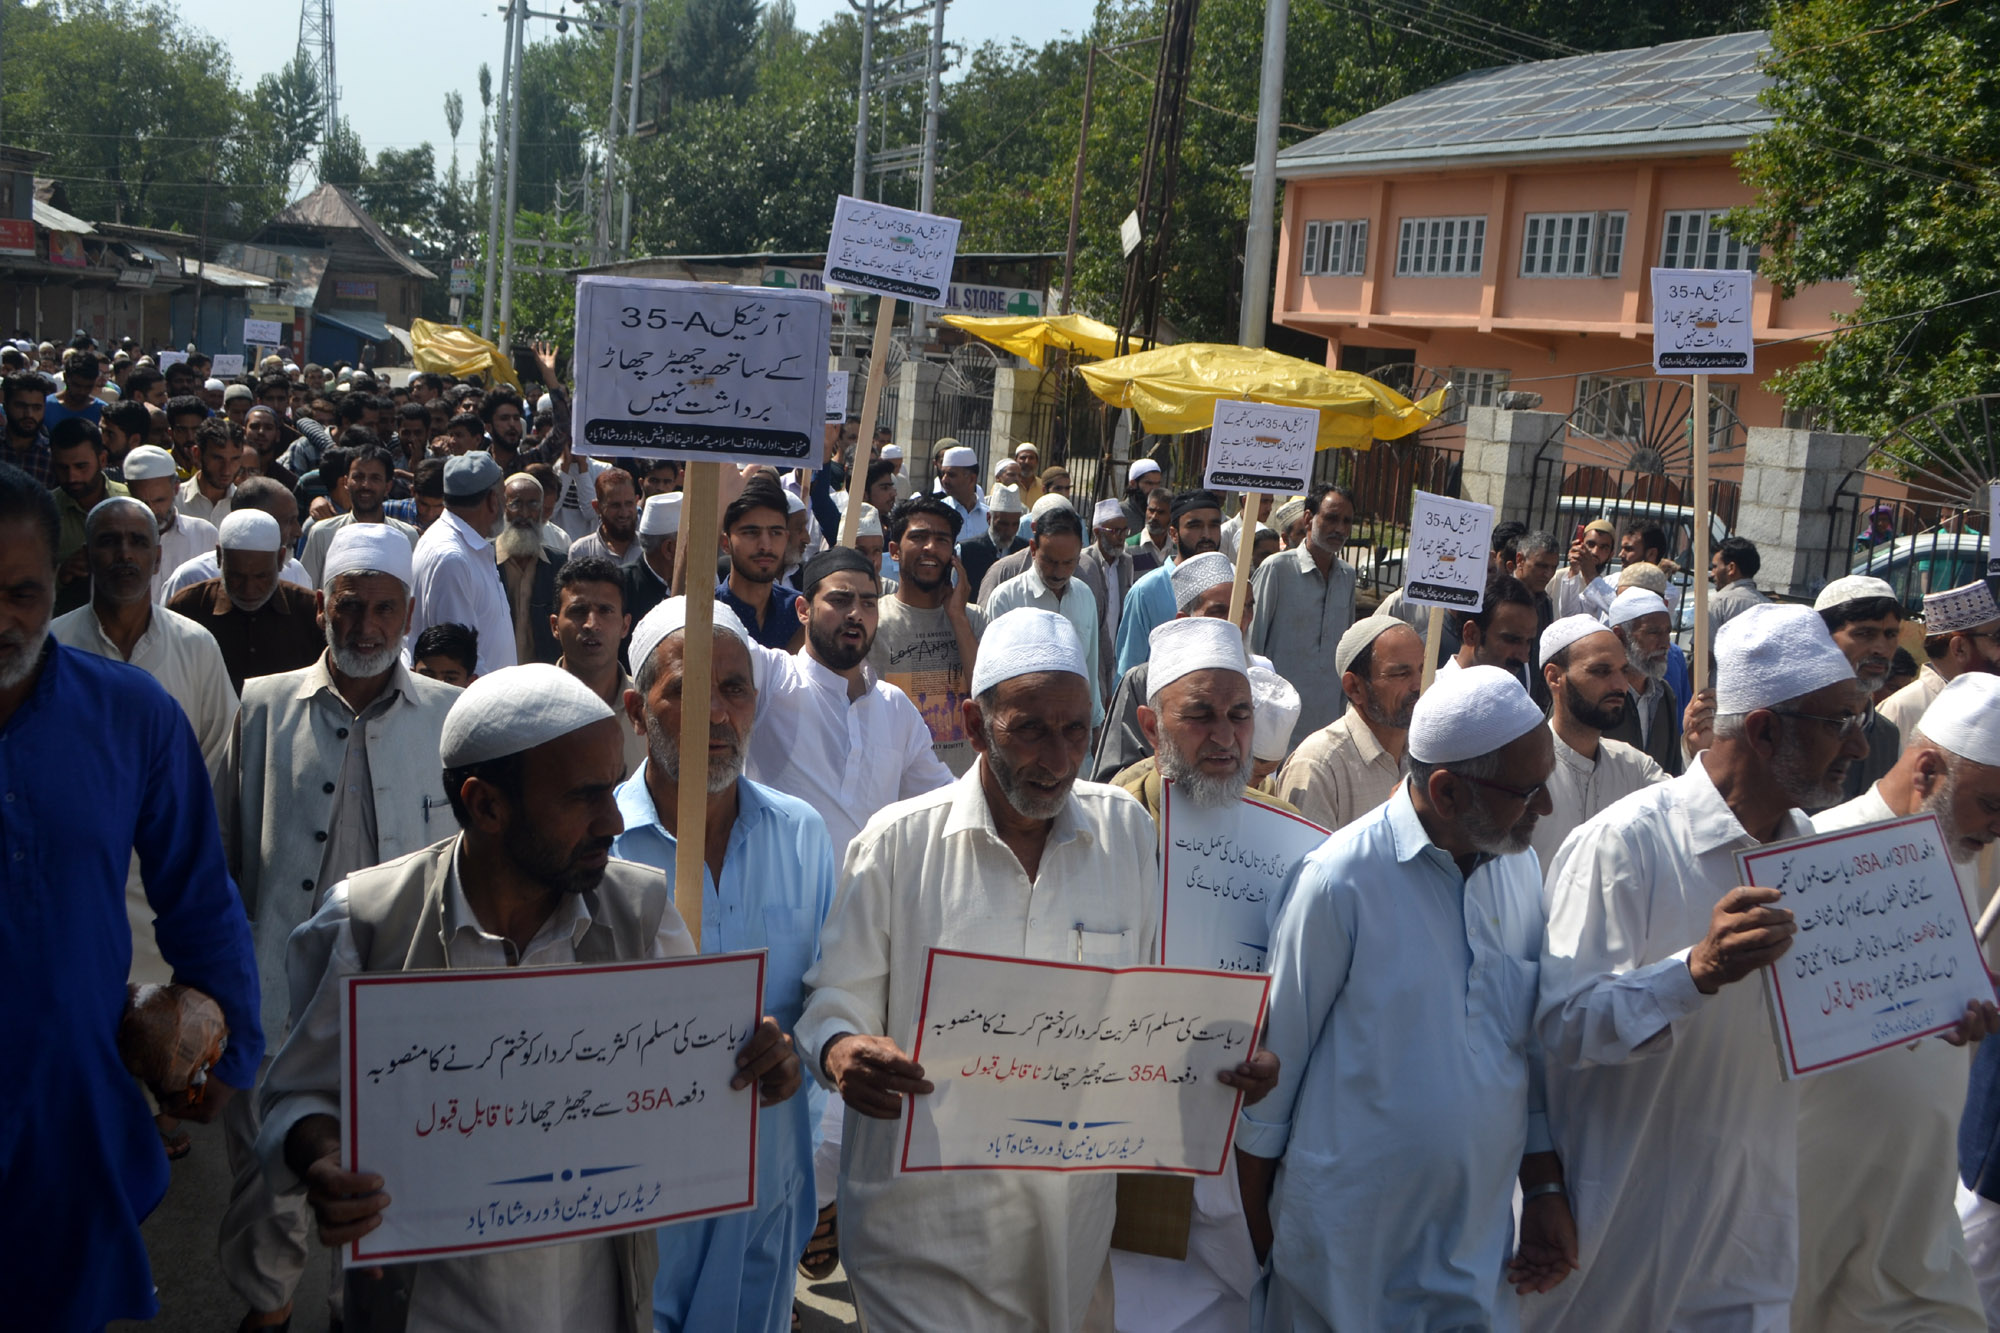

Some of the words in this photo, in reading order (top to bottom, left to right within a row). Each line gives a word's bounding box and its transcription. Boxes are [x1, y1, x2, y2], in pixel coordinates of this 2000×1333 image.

[964, 288, 1005, 311] STORE
[621, 307, 711, 333] 35-A
[710, 302, 791, 341] آرٹیکل
[598, 346, 654, 381] چھاڑ
[652, 347, 707, 377] چھیڑ
[704, 352, 766, 378] ساتھ
[764, 354, 806, 381] کے
[628, 382, 686, 416] نہیں
[674, 390, 772, 422] برداشت
[1175, 837, 1203, 852] حمایت
[1203, 835, 1224, 856] مکمل
[1219, 840, 1231, 861] کی
[1230, 845, 1246, 863] کال
[1245, 850, 1267, 875] ہڑتال
[1268, 854, 1281, 876] گئی
[1187, 865, 1200, 888] گی
[1198, 875, 1221, 897] جائے
[1222, 877, 1233, 897] کی
[931, 1009, 983, 1035] منصوبہ
[981, 1015, 998, 1035] کا
[992, 1011, 1044, 1036] کرنے
[1036, 1011, 1064, 1047] ختم
[1057, 1015, 1075, 1041] کو
[1066, 1018, 1104, 1040] کردار
[1099, 1013, 1150, 1044] اکثریت
[1147, 1011, 1185, 1047] مسلم
[1176, 1015, 1201, 1044] کی
[521, 1031, 545, 1066] کو
[535, 1029, 583, 1064] کردار
[575, 1023, 643, 1066] اکثریت
[641, 1022, 679, 1066] مسلم
[673, 1021, 697, 1054] کی
[692, 1021, 749, 1050] ریاست
[1191, 1028, 1245, 1050] ریاست
[367, 1044, 426, 1084] منصوبہ
[425, 1046, 449, 1072] کا
[442, 1035, 505, 1072] کرنے
[500, 1029, 528, 1079] ختم
[961, 1056, 999, 1078] قبول
[1042, 1067, 1077, 1091] چھاڑ
[1073, 1061, 1106, 1087] چھیڑ
[1101, 1071, 1127, 1085] سے
[1127, 1064, 1169, 1083] 35A
[1168, 1066, 1199, 1085] دفعہ
[626, 1087, 674, 1113] 35A
[675, 1080, 706, 1107] دفعہ
[415, 1098, 457, 1138] قبول
[515, 1102, 556, 1133] چھاڑ
[554, 1089, 594, 1128] چھیڑ
[591, 1099, 624, 1117] سے
[1062, 1138, 1095, 1161] یونین
[1095, 1137, 1145, 1160] ٹریڈرس
[561, 1186, 603, 1223] یونین
[604, 1181, 661, 1216] ٹریڈرس
